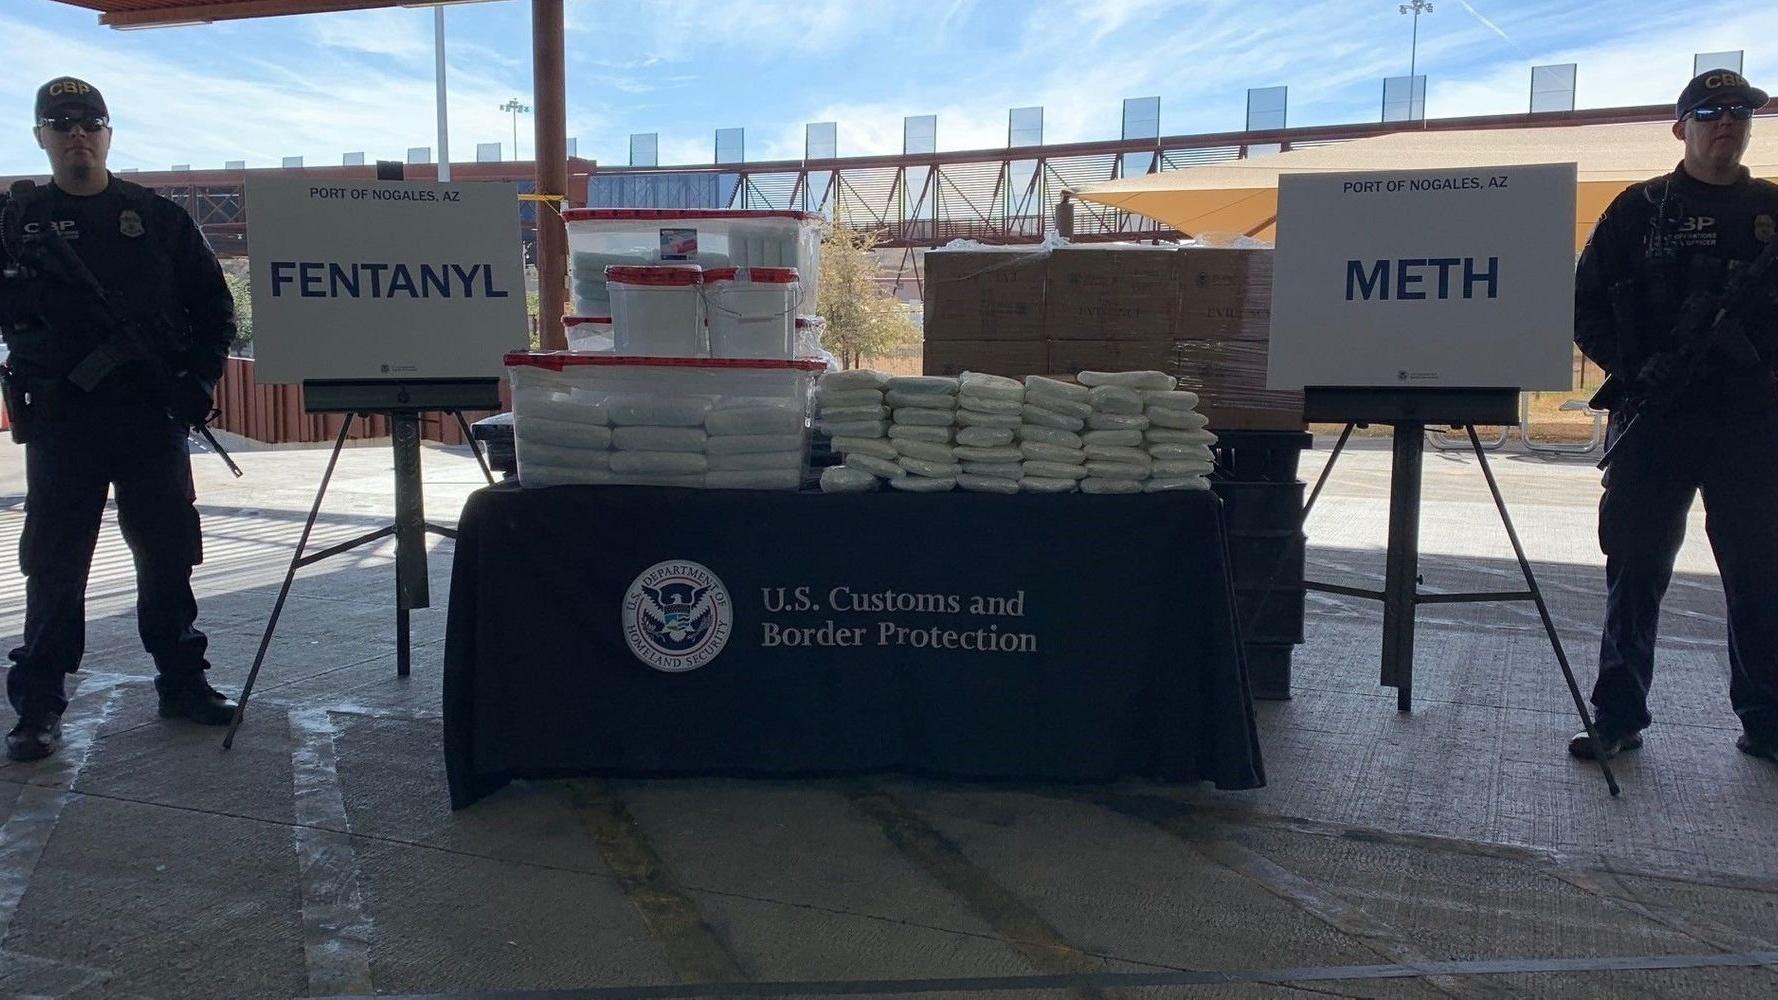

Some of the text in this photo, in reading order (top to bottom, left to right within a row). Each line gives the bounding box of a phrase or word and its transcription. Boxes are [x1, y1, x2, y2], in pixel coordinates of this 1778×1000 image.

[49, 81, 90, 97] CBP
[1705, 74, 1746, 90] CBP
[310, 187, 460, 202] PORT OF NOGALES, AZ
[1343, 176, 1508, 194] PORT OF NOGALES, AZ
[271, 261, 508, 298] FENTANYL
[1345, 257, 1499, 301] METH
[627, 566, 728, 611] U.S. DEPARTMENT OF
[761, 586, 1025, 617] U.S. Customs and
[627, 620, 728, 667] HOMELAND SECURITY
[761, 620, 1037, 652] Border Protection
